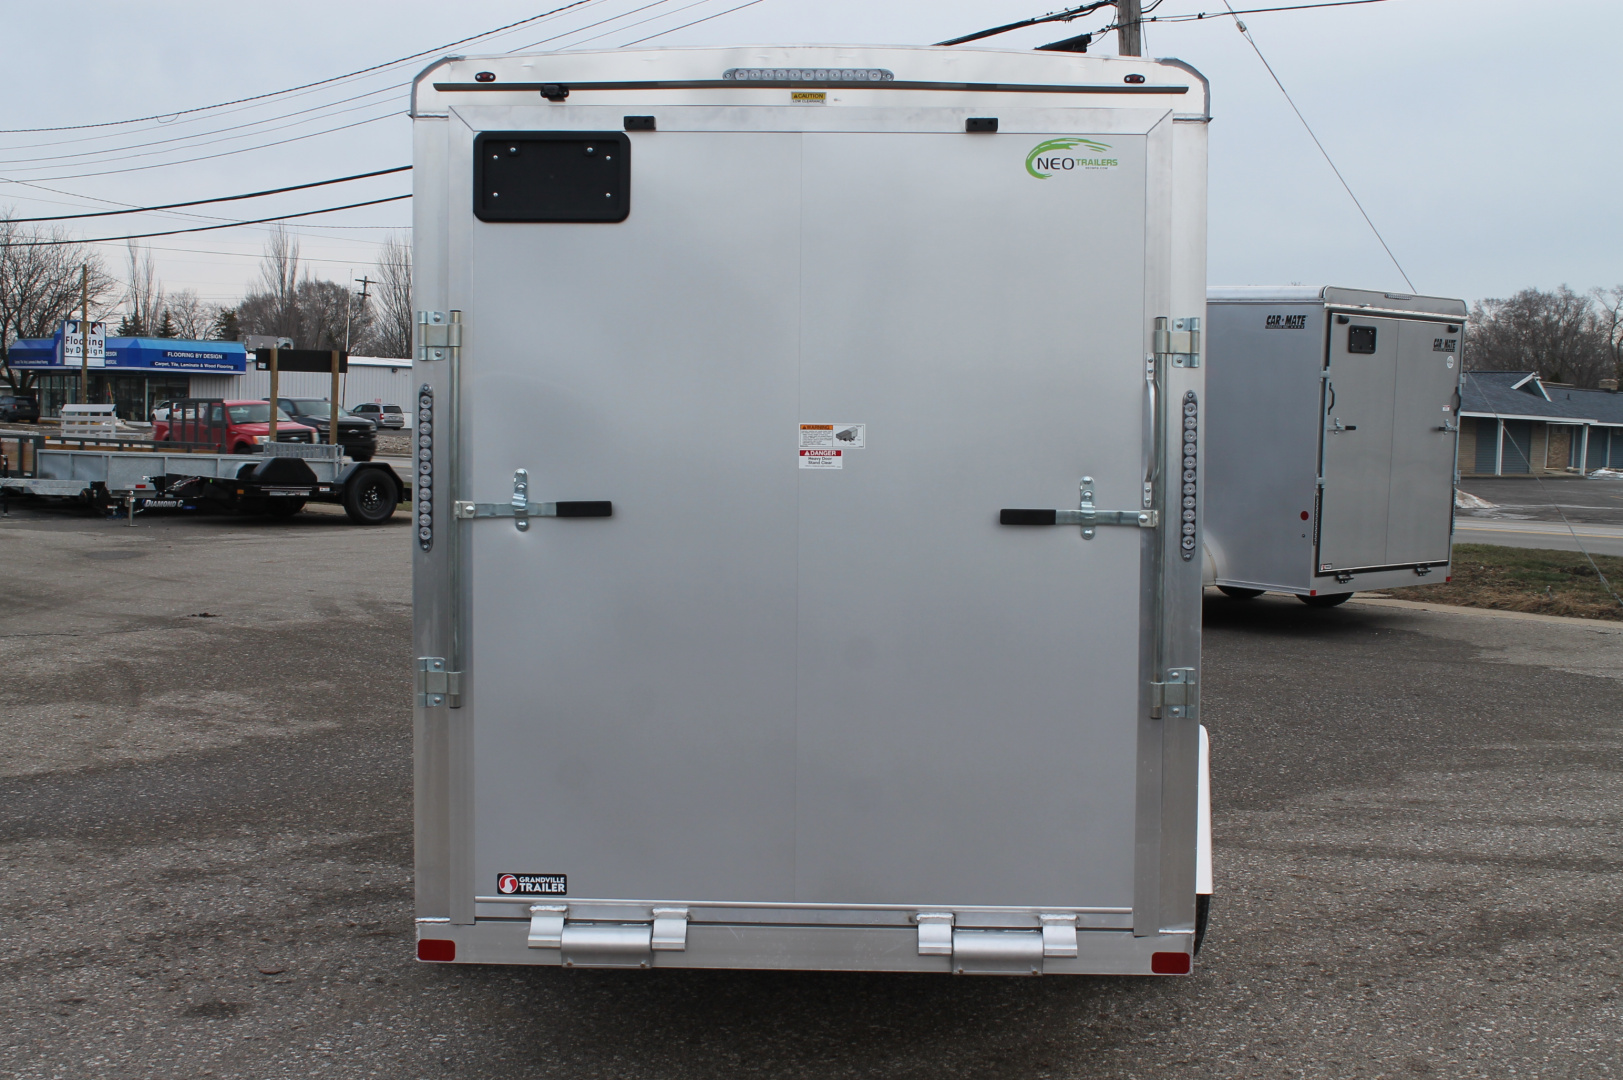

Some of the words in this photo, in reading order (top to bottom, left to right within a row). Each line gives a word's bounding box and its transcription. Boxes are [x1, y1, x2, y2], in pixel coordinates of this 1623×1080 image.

[1037, 158, 1074, 170] NEO
[1076, 158, 1118, 166] TRAILERS
[519, 883, 565, 892] TRAILER
